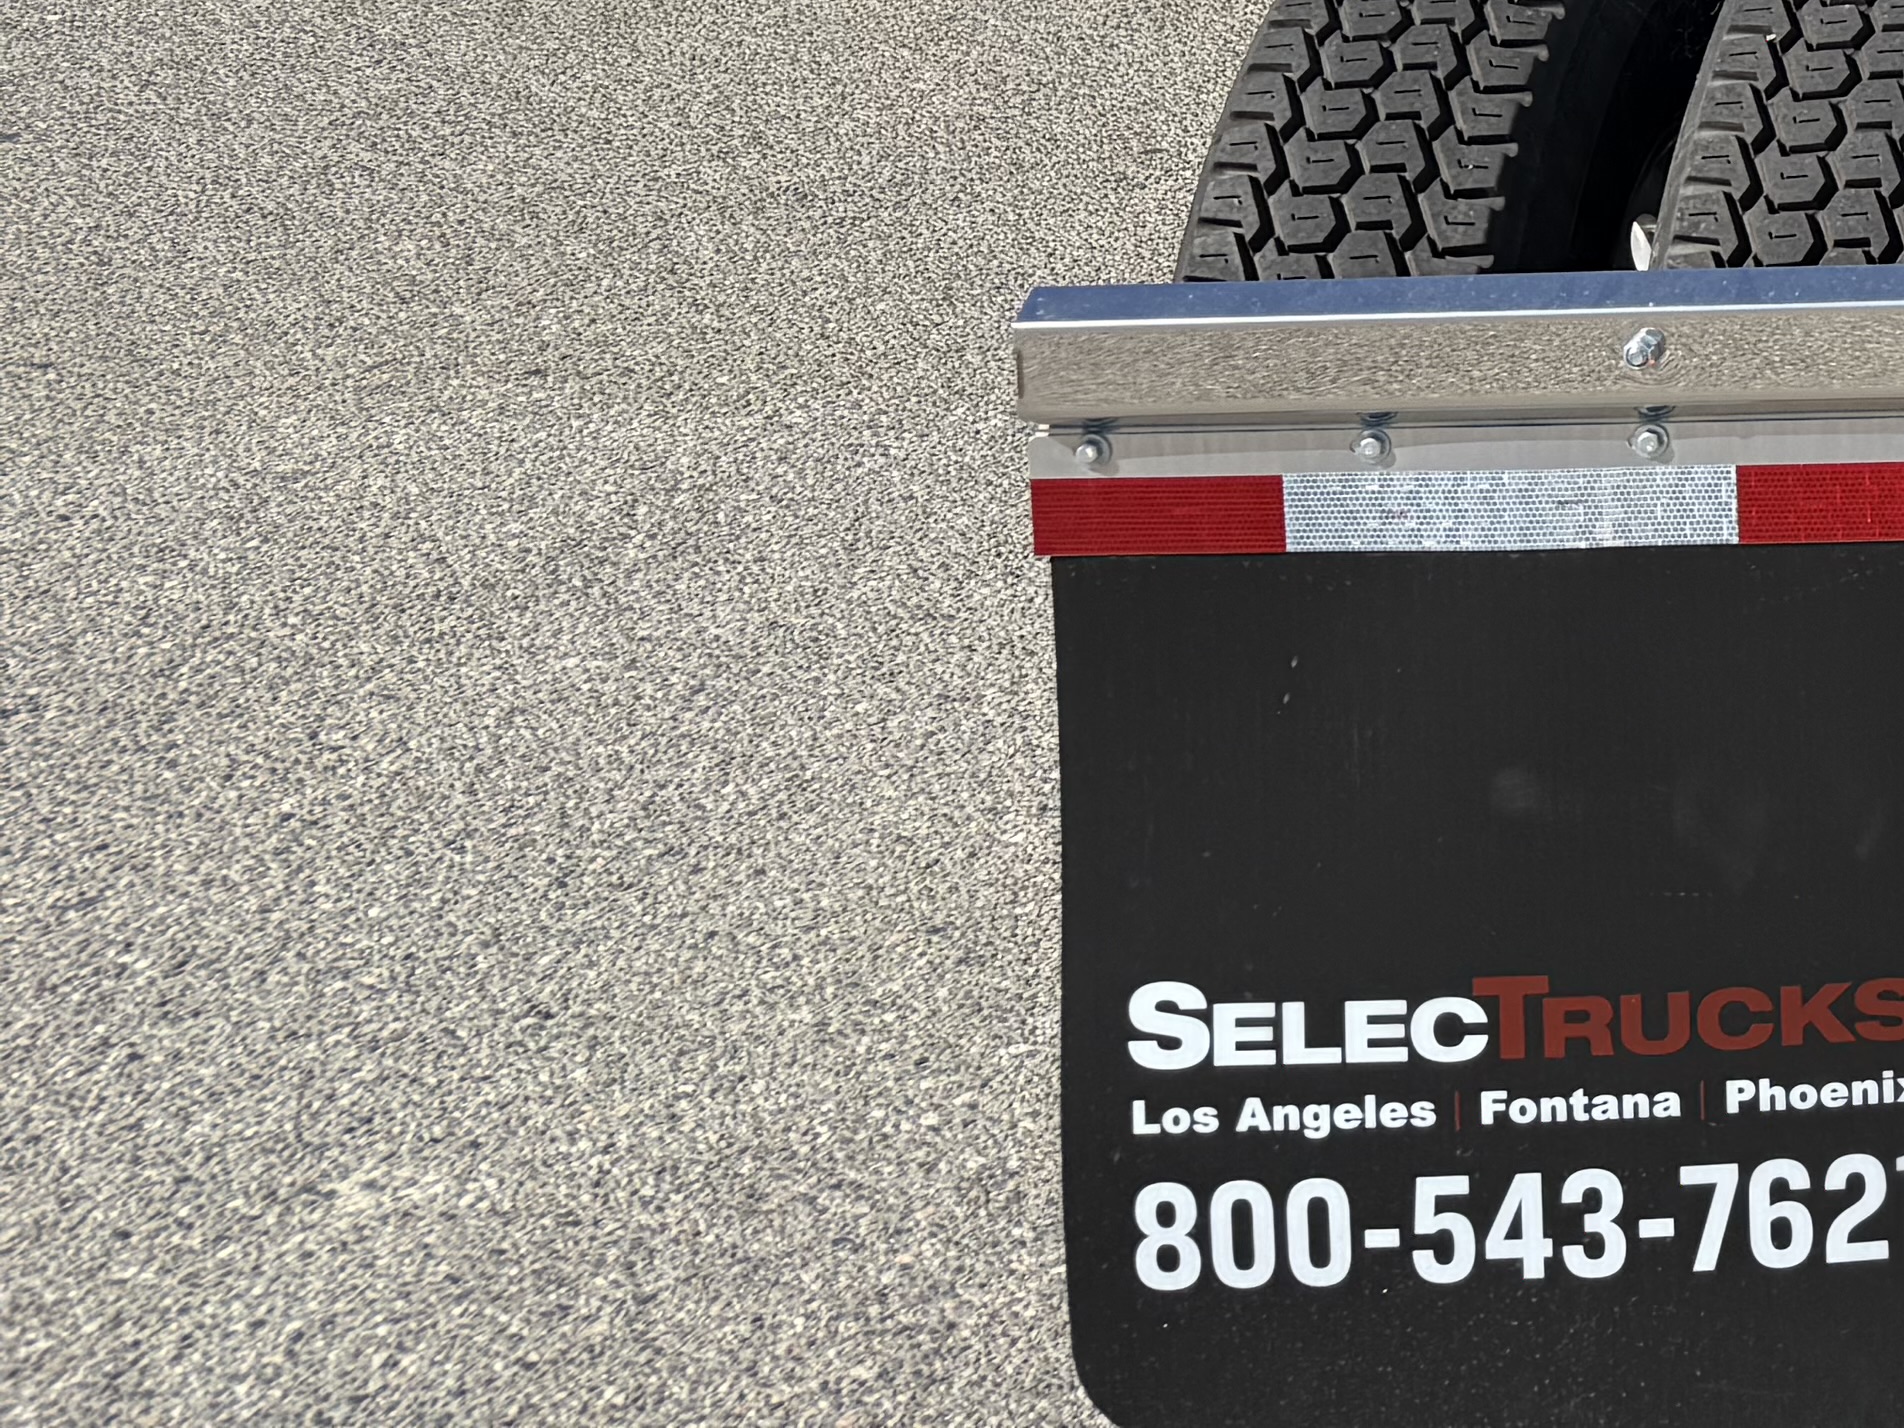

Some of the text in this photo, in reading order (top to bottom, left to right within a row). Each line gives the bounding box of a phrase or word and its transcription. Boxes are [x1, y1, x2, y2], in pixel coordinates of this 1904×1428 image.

[1131, 1100, 1220, 1136] Los
[1235, 1087, 1438, 1140] Angeles
[1480, 1086, 1682, 1126] Fontana
